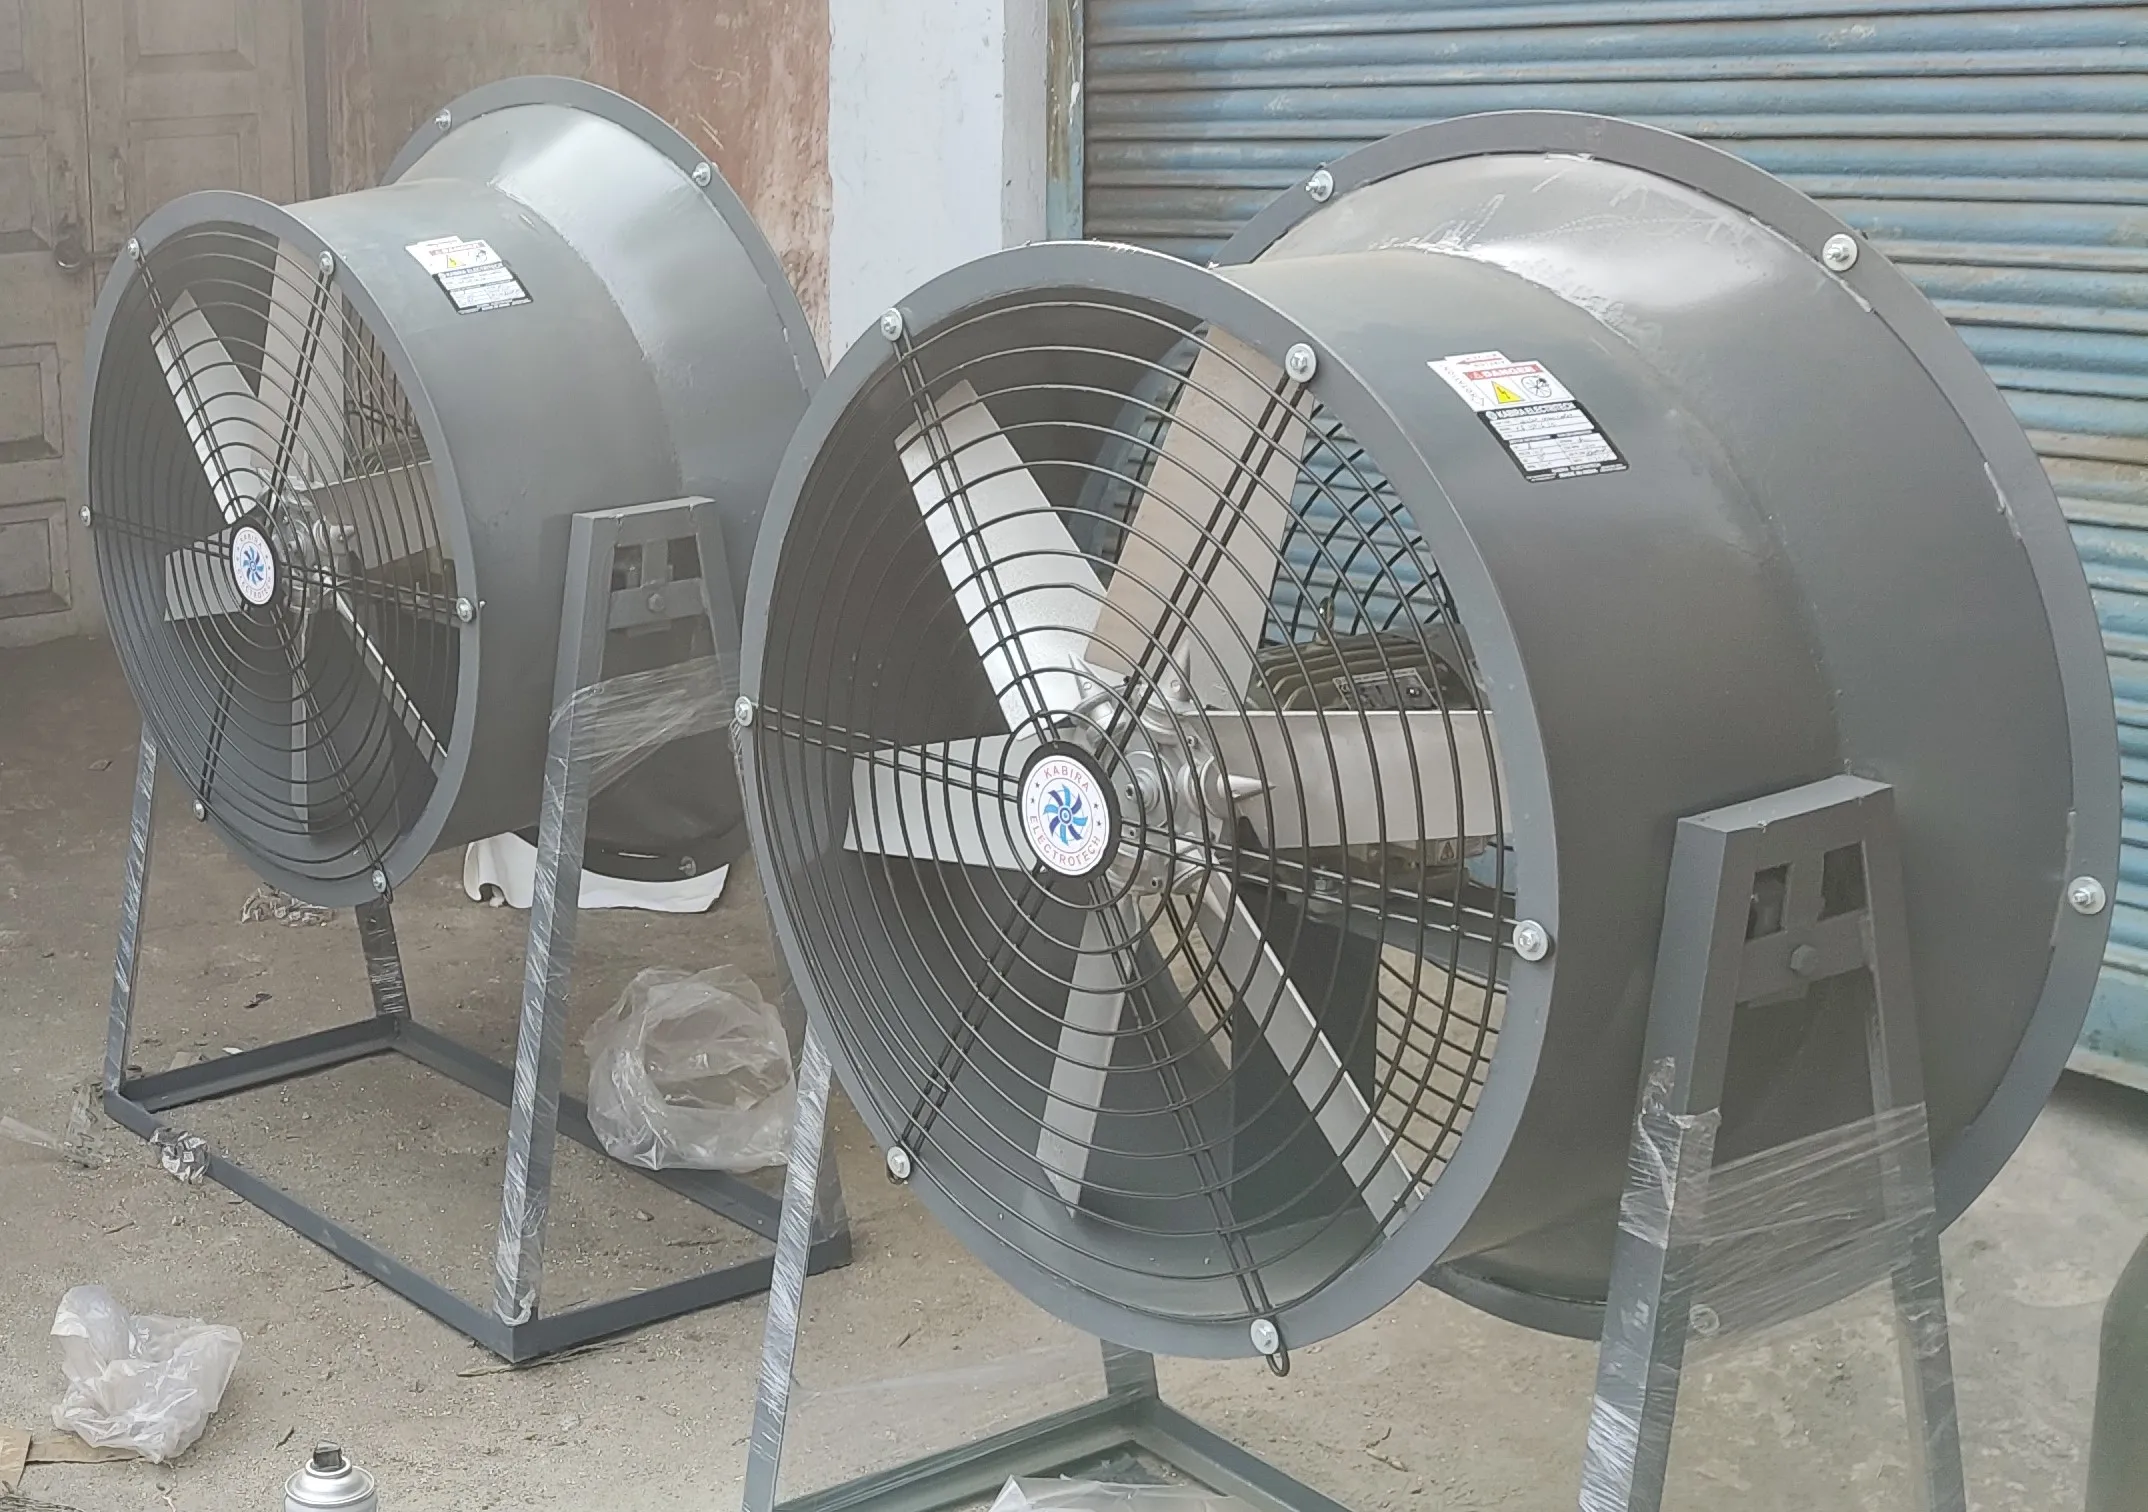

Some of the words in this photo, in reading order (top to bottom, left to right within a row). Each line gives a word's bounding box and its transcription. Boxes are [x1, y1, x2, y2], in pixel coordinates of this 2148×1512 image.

[1482, 365, 1536, 379] DANGER
[1043, 765, 1089, 792] KABIRA
[1030, 815, 1100, 867] ELECTROTECH
